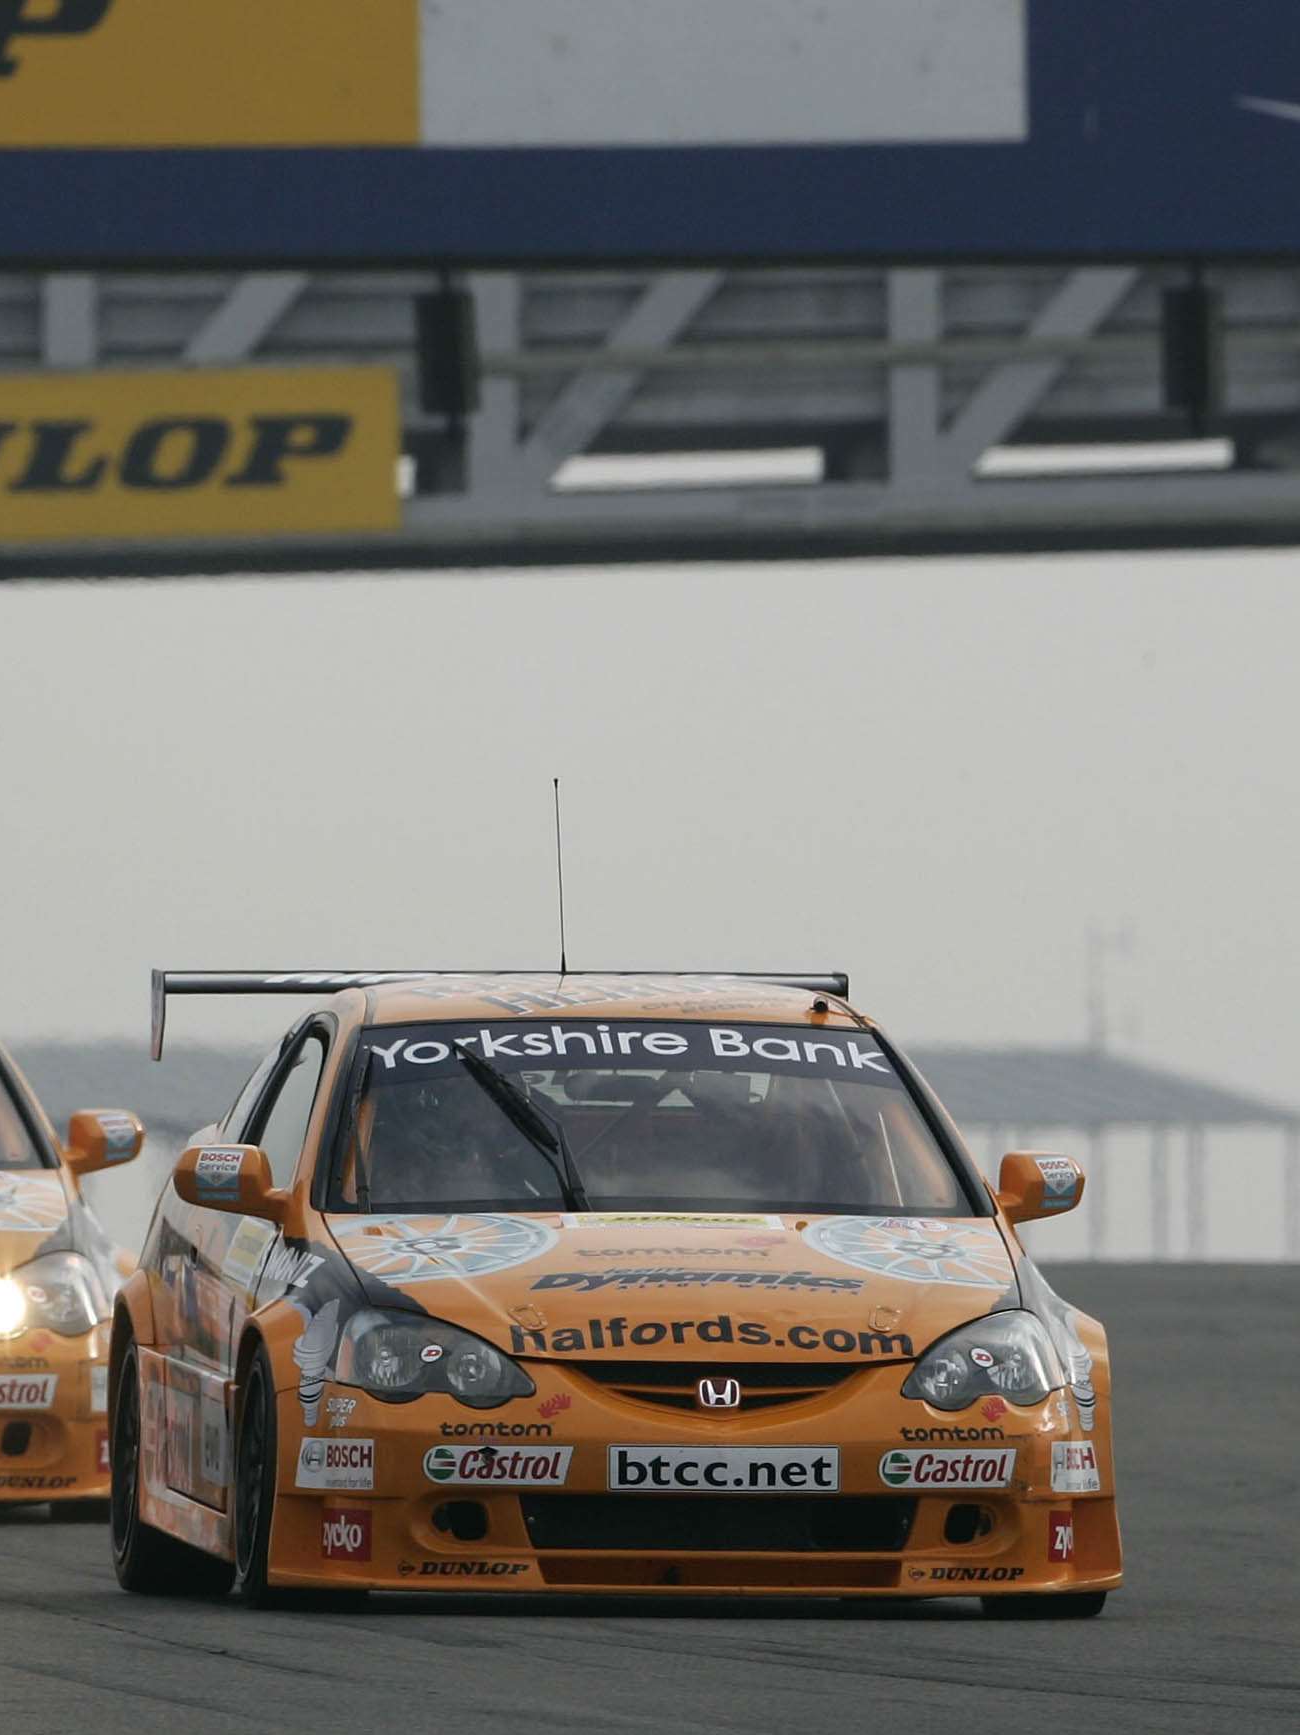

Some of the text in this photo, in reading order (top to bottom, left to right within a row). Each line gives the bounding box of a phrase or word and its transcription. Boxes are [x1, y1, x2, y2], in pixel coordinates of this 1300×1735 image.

[371, 1024, 891, 1073] Yorkshire Bank
[198, 1162, 237, 1171] Service
[200, 1153, 241, 1162] BOSCH
[509, 1313, 915, 1356] halfords.com
[440, 1421, 552, 1437] tomtom
[900, 1425, 1004, 1442] tomtom
[326, 1445, 373, 1468] BOSCH
[458, 1449, 562, 1481] Castrol
[617, 1449, 833, 1487] btcc.net
[913, 1453, 1008, 1483] Castrol
[419, 1561, 530, 1576] DUNLOP
[929, 1567, 1025, 1581] DUNLOP
